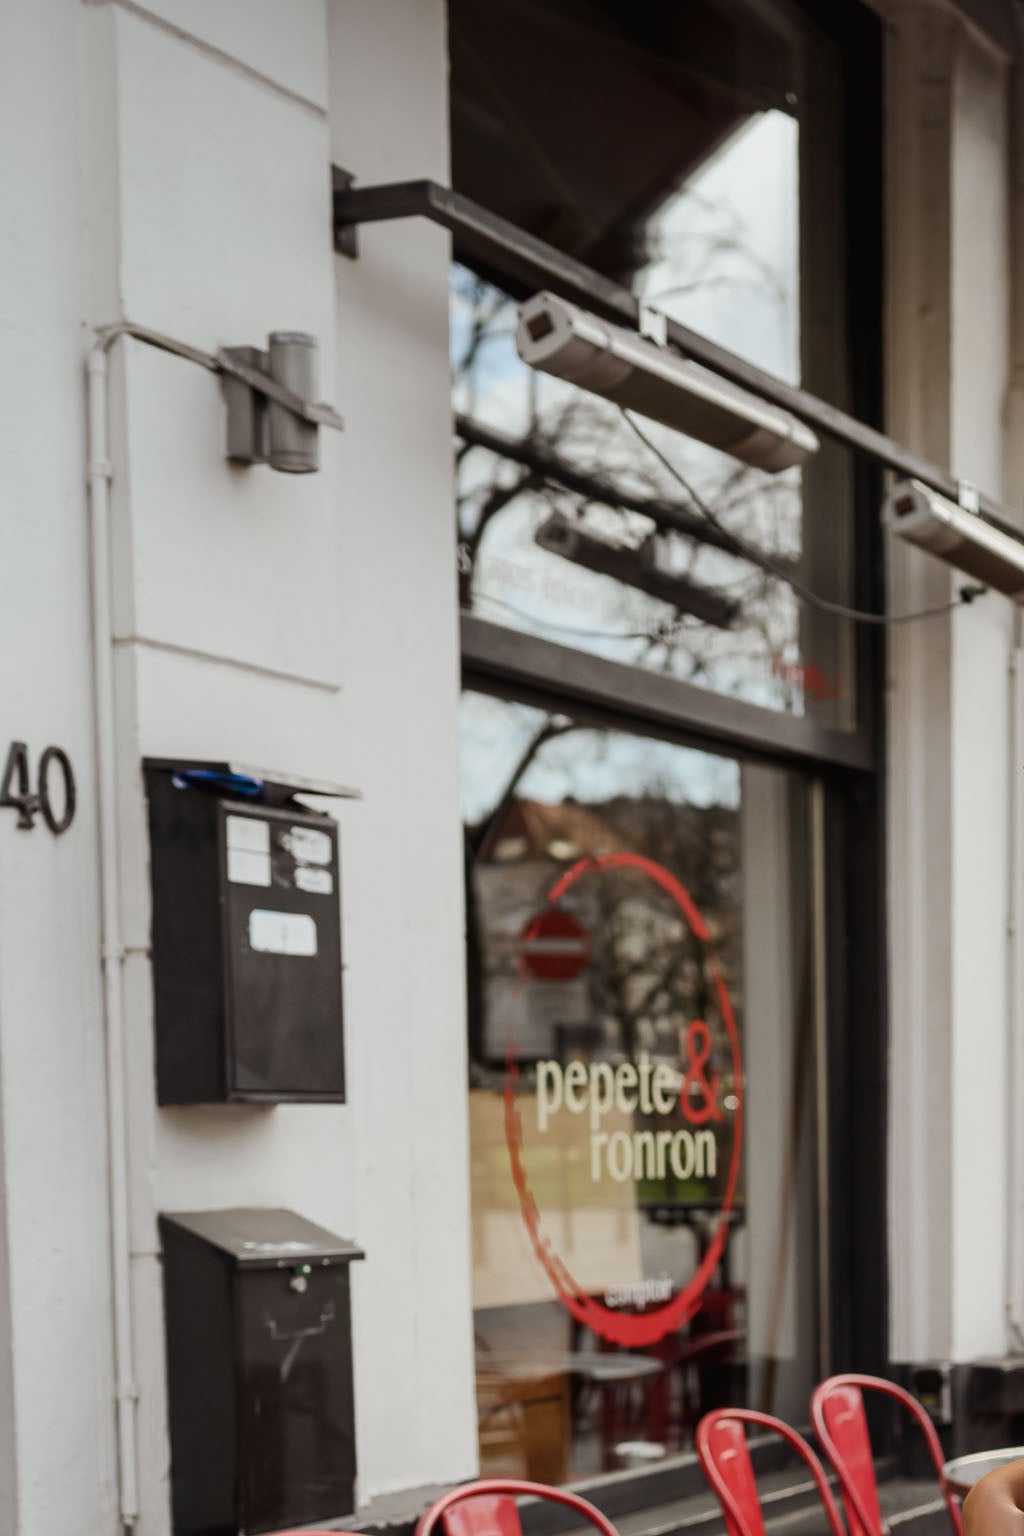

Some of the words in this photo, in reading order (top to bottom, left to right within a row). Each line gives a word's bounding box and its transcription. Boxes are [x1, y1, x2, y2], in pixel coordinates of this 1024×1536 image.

[0, 741, 76, 835] 40
[536, 1052, 677, 1132] pepete
[680, 1020, 723, 1123] &
[590, 1129, 716, 1181] ronron
